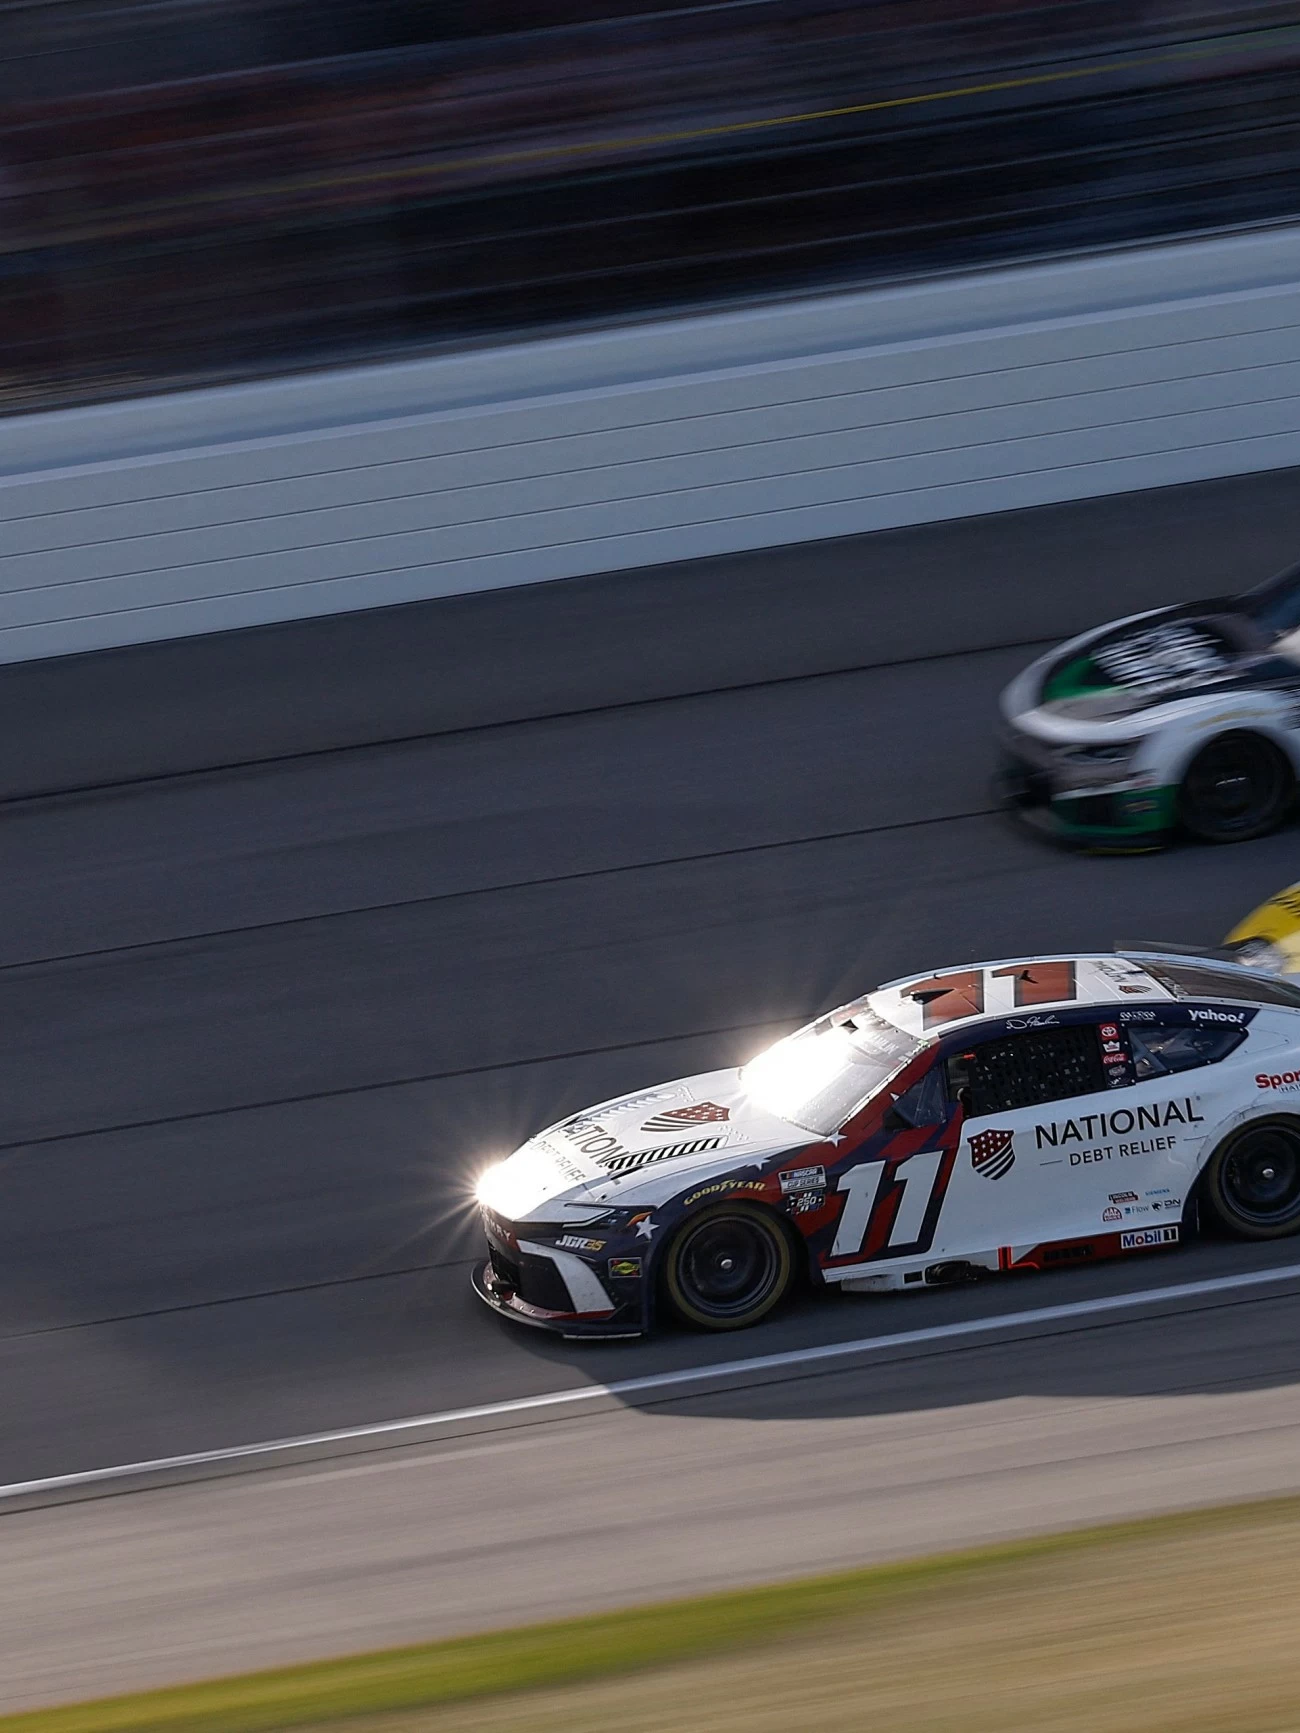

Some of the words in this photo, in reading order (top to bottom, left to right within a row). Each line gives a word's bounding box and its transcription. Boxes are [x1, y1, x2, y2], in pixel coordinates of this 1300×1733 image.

[1188, 1009, 1246, 1024] yahoo!
[1035, 1097, 1205, 1149] NATIONAL
[1069, 1147, 1113, 1166] DEBT
[1119, 1136, 1177, 1158] RELIEF
[683, 1179, 767, 1206] GOODYEAR
[796, 1196, 817, 1207] 250
[830, 1150, 944, 1257] 11
[1132, 1205, 1149, 1213] Flow
[1123, 1230, 1161, 1247] Mobil
